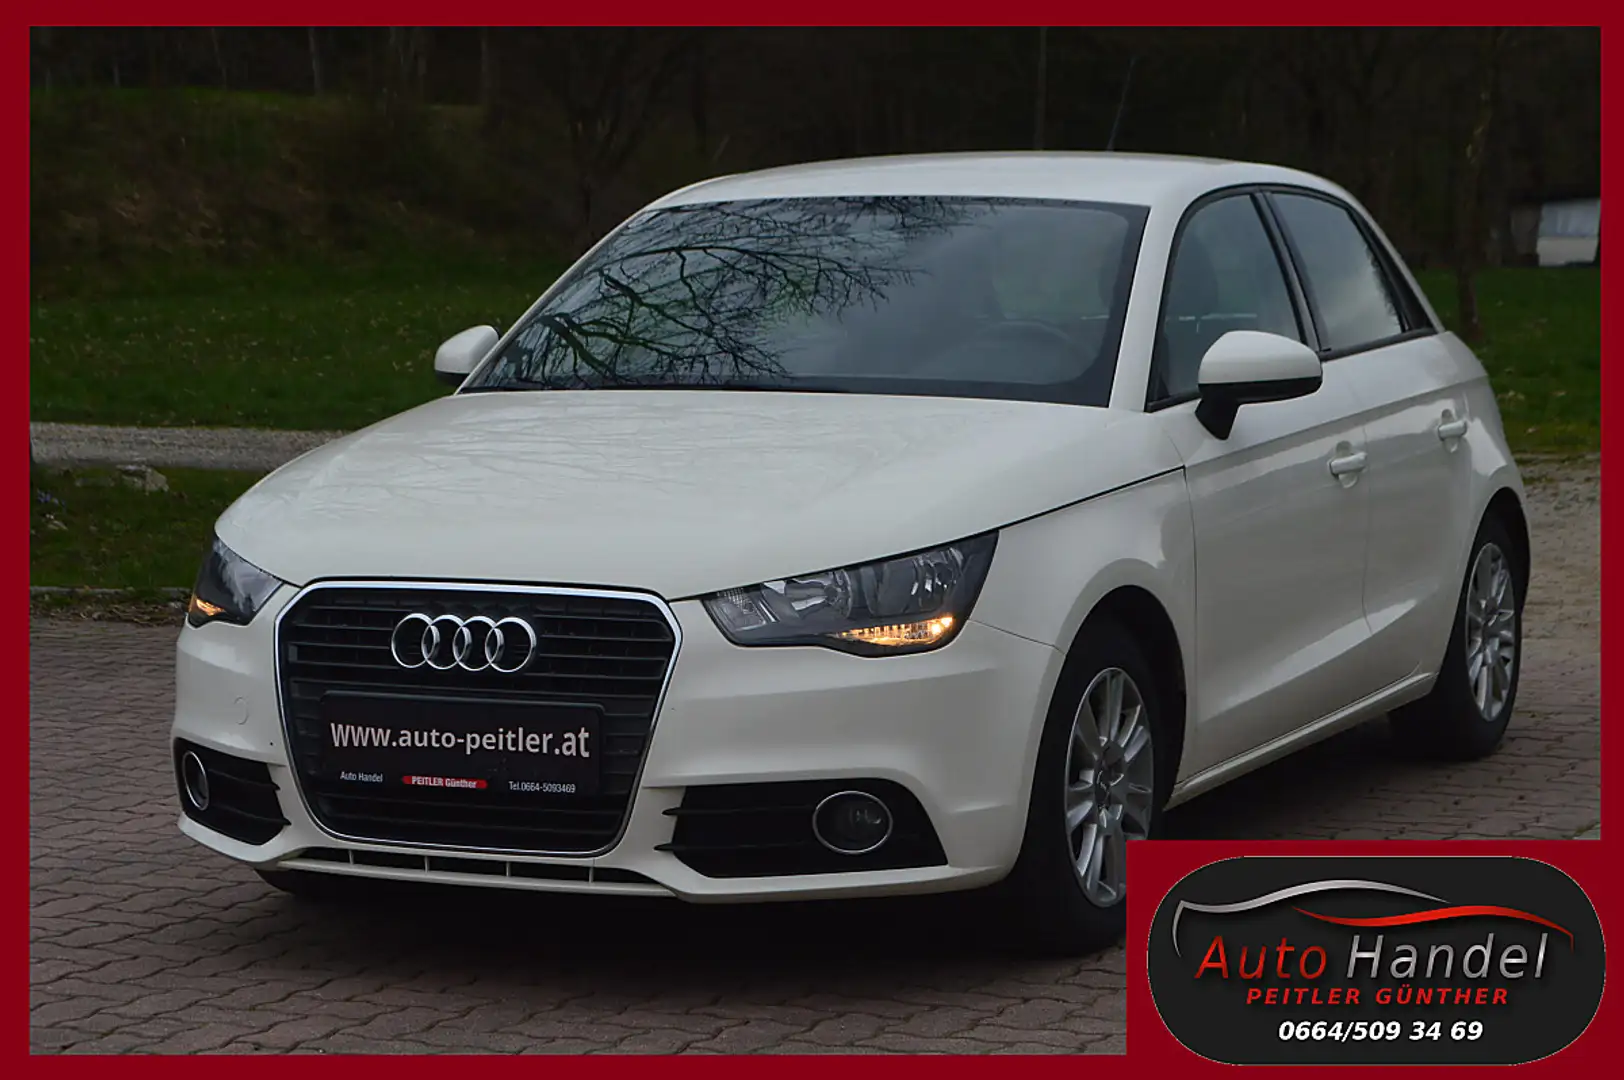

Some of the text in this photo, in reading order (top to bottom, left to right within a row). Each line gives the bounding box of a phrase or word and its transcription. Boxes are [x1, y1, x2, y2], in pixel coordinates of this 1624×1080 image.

[339, 771, 383, 783] Auto Handel
[411, 775, 477, 789] PEITLER Günther
